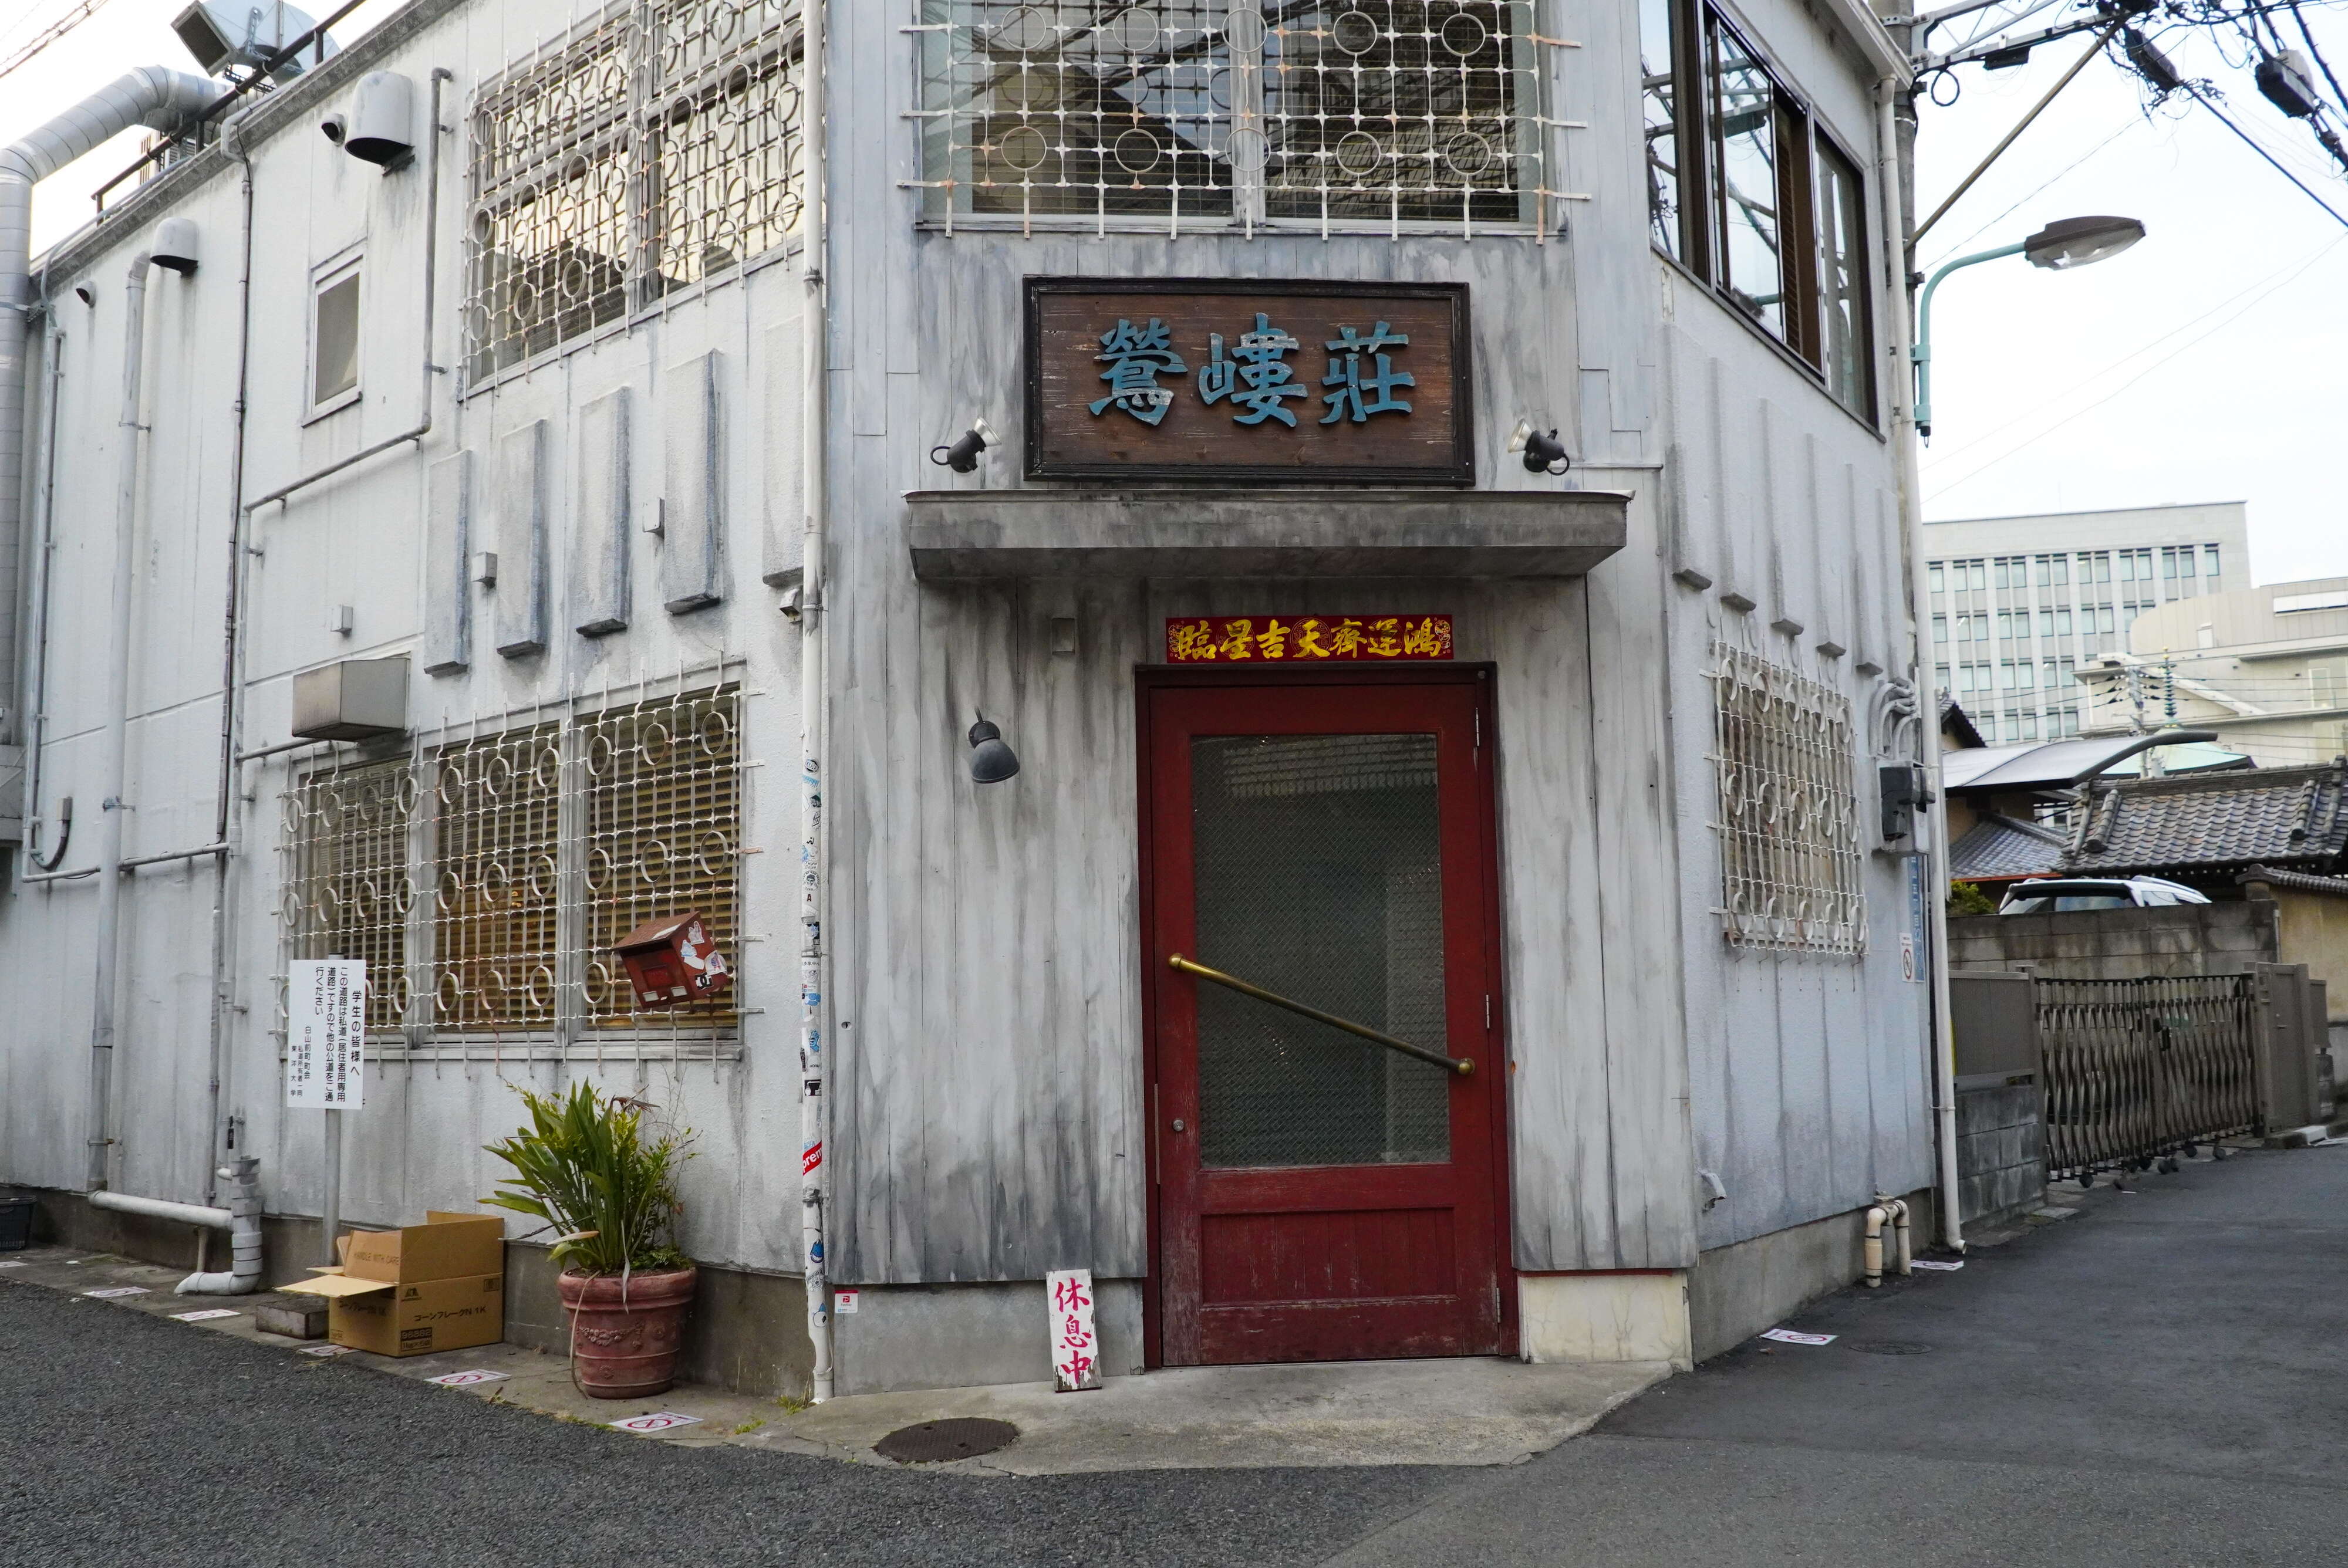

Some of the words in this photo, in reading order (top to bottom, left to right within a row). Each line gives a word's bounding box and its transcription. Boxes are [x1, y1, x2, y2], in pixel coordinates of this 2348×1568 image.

[315, 967, 324, 1015] 行ください
[350, 991, 362, 1076] 学生の皆様へ
[1055, 1278, 1092, 1384] 休息中
